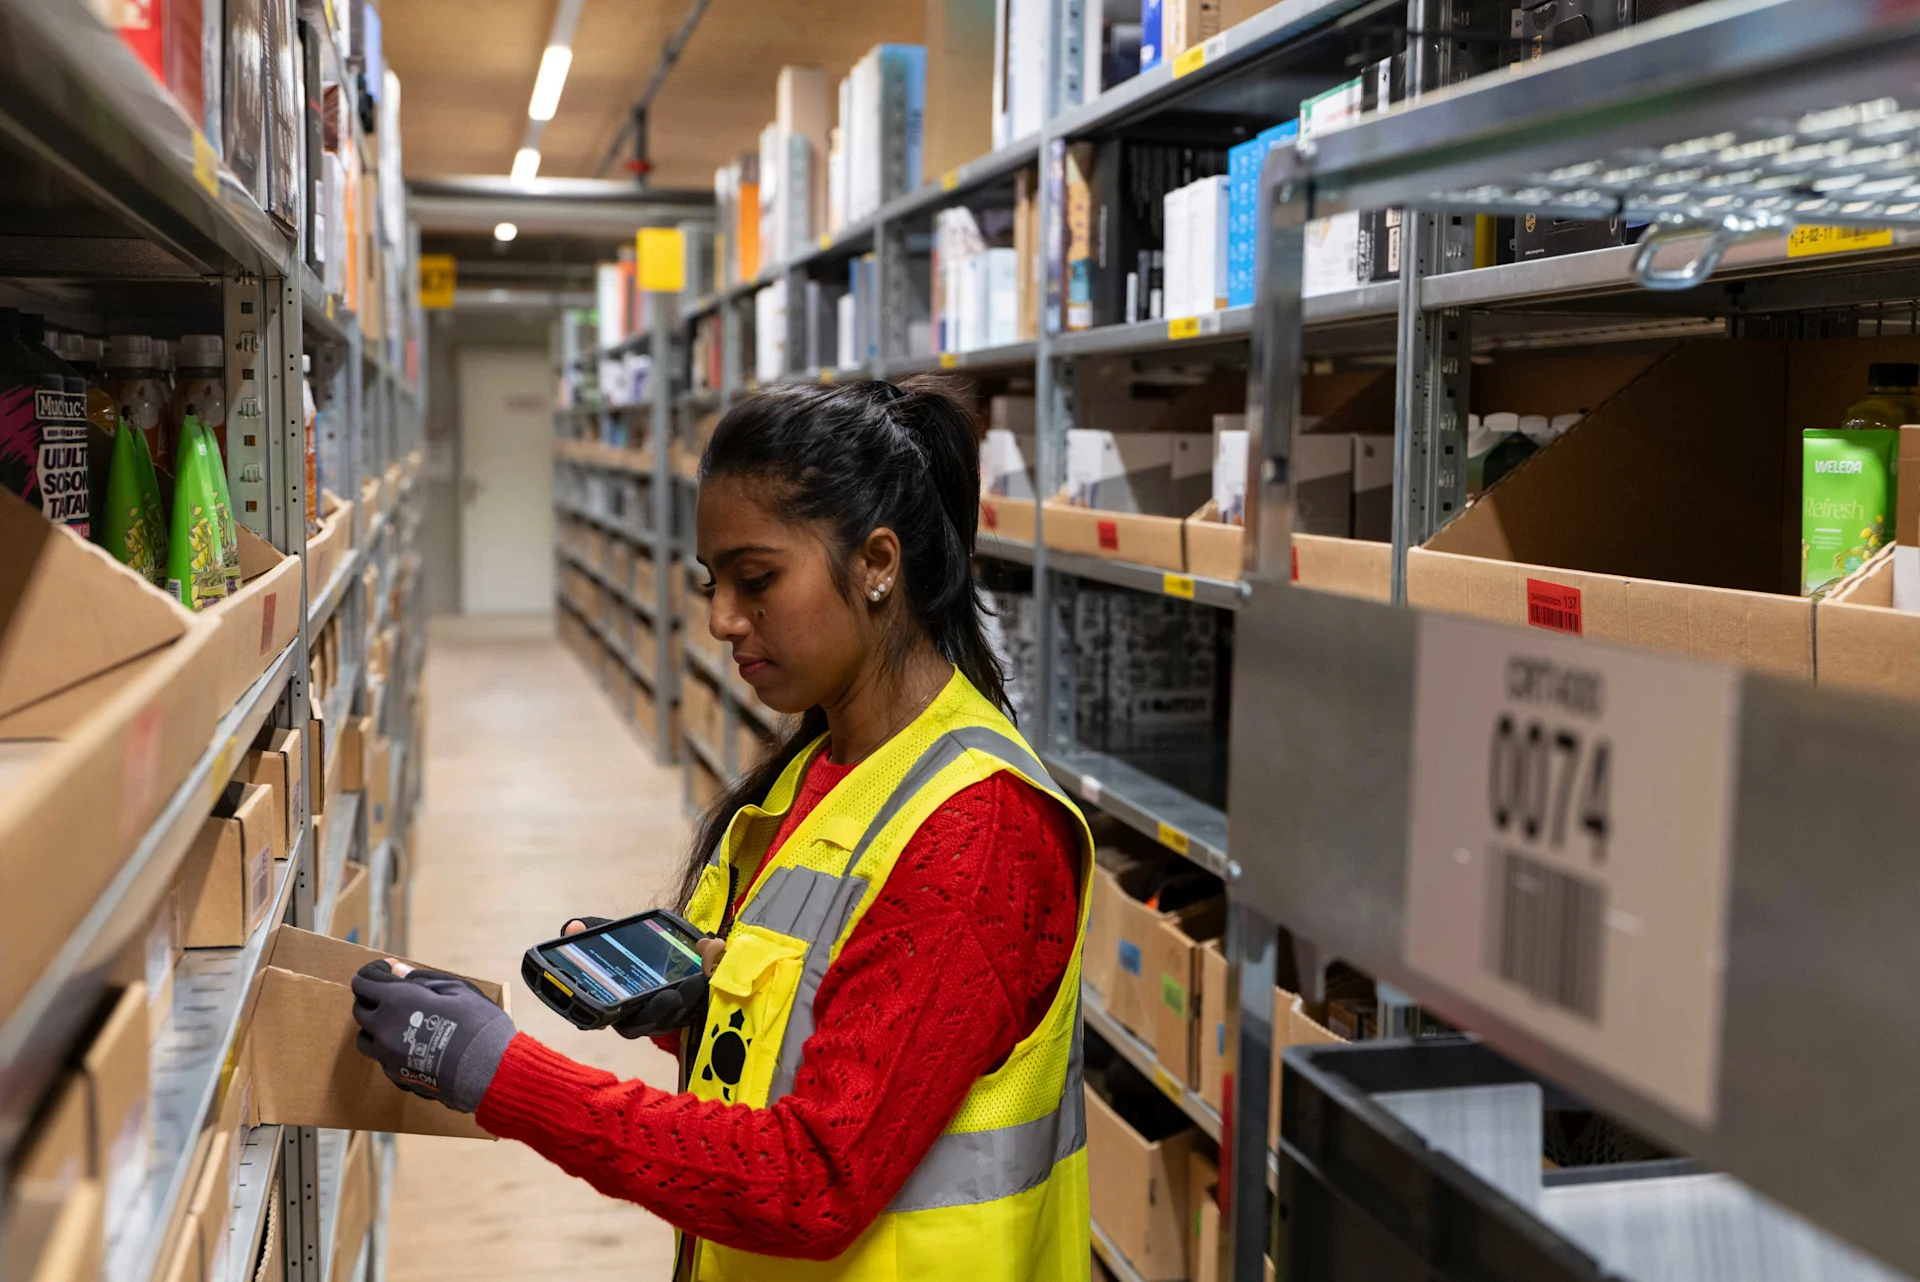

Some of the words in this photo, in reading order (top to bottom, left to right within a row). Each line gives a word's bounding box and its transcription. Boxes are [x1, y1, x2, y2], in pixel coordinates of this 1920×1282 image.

[1814, 460, 1863, 474] WELEDA
[1804, 497, 1865, 520] Refresh
[1564, 595, 1577, 610] 137
[1489, 713, 1612, 864] 0074
